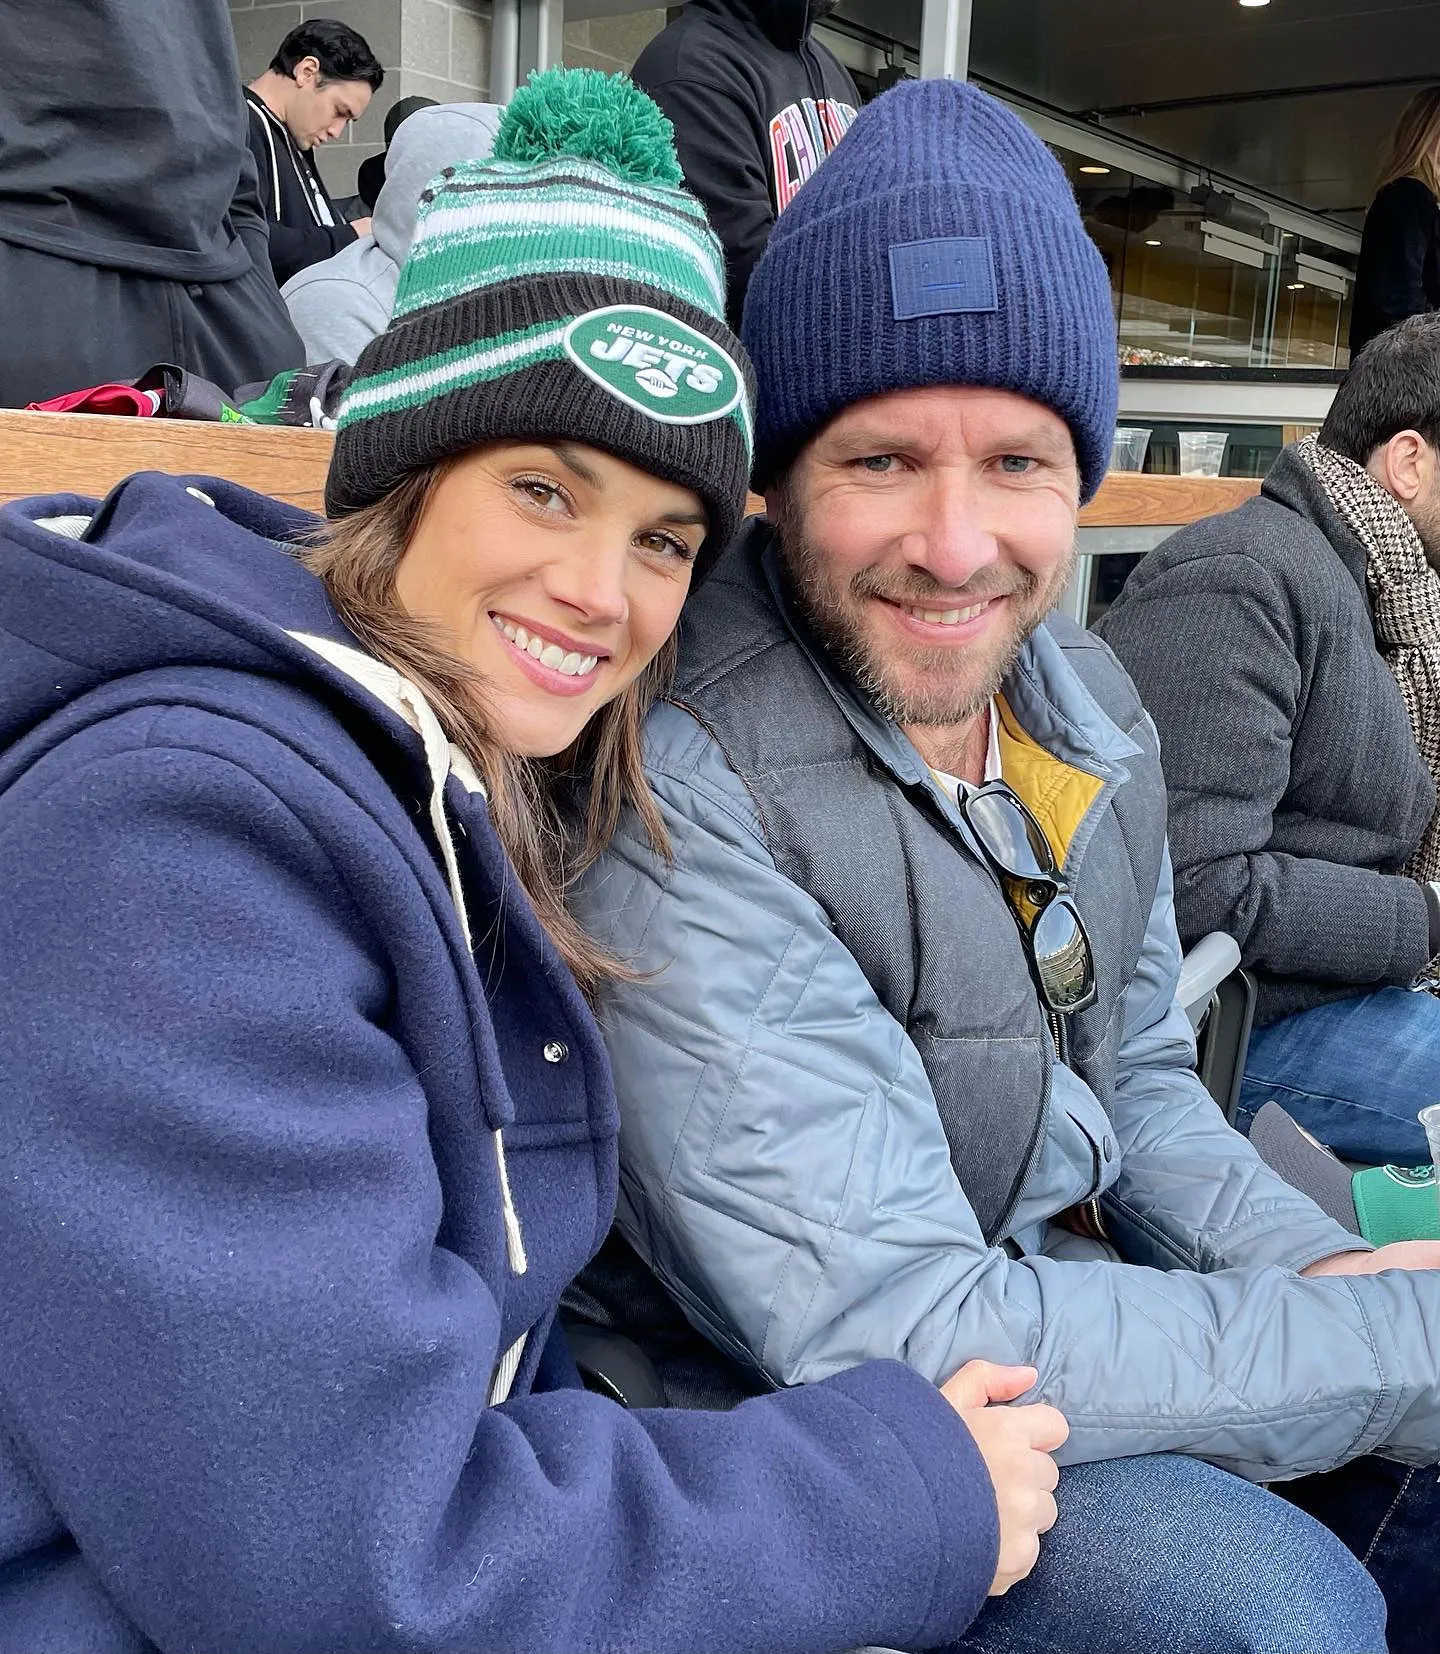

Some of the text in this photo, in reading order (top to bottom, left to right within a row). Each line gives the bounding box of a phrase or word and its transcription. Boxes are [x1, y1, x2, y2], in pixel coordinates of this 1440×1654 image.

[589, 336, 724, 394] JETS
[606, 322, 709, 360] NEW YORK
